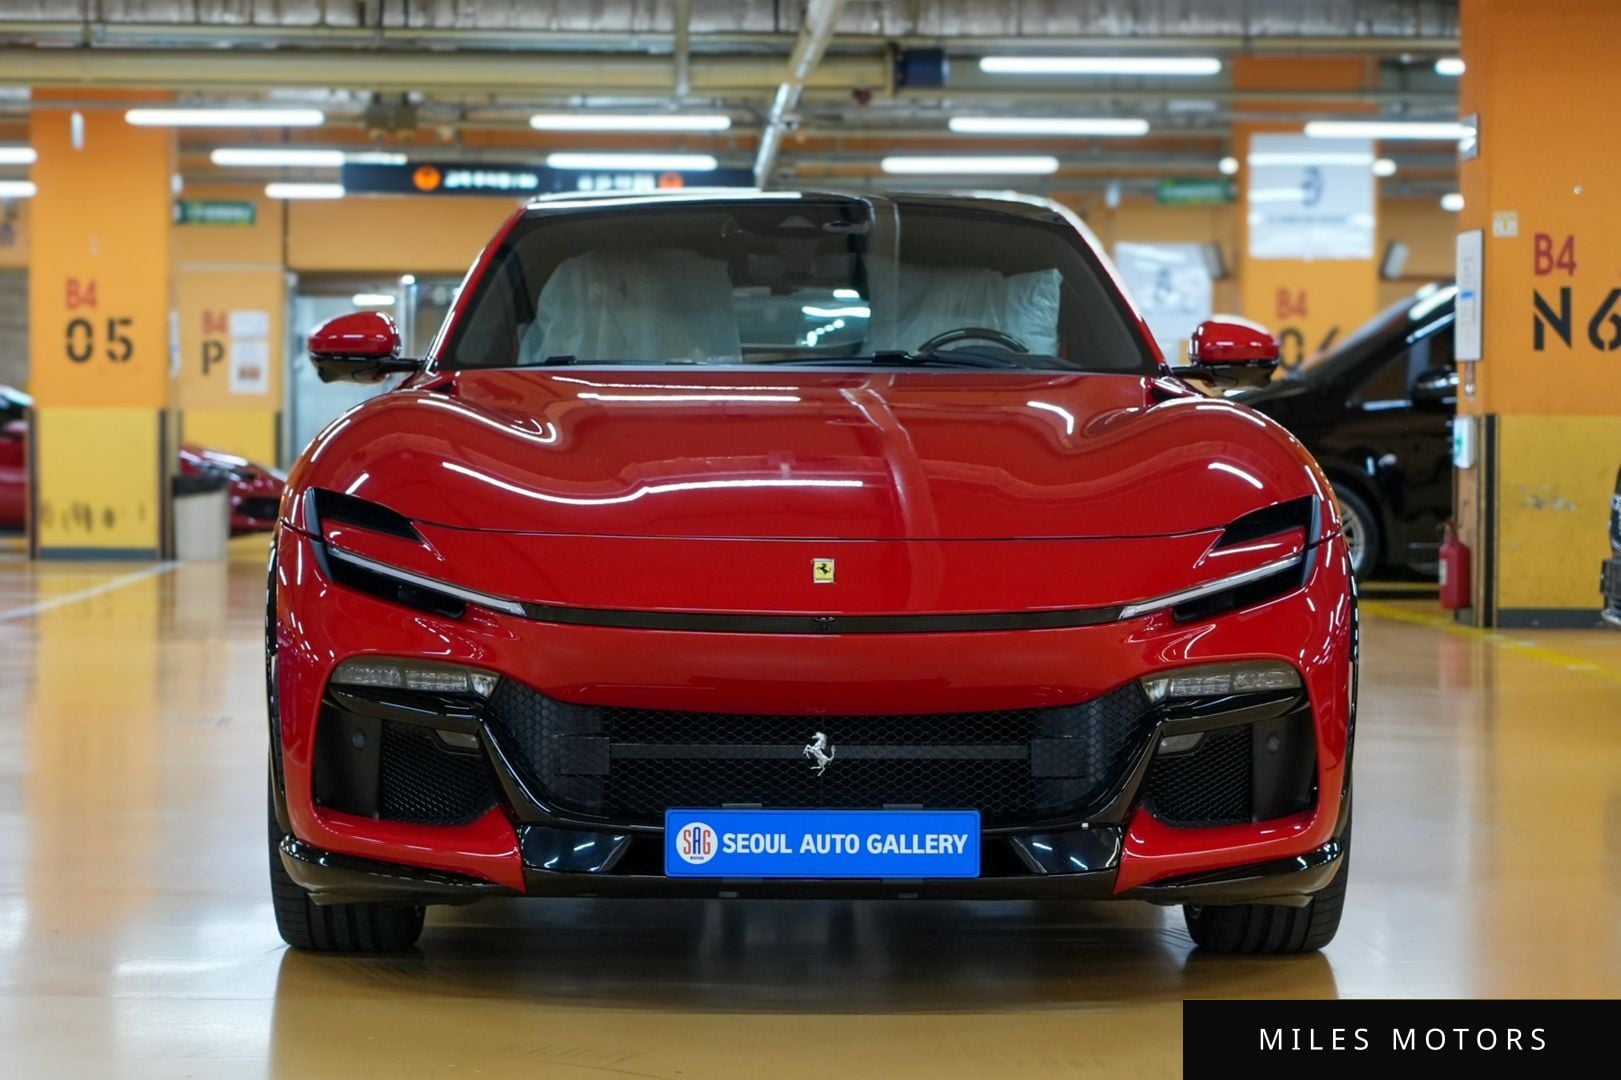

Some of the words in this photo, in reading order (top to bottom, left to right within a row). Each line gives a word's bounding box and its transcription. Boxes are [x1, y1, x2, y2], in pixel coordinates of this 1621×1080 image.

[1533, 232, 1577, 277] B4
[65, 276, 98, 310] B4
[1276, 287, 1309, 321] B4
[201, 310, 228, 335] B4
[1533, 287, 1621, 351] N6
[65, 318, 134, 363] 05
[201, 341, 225, 375] P
[683, 826, 711, 855] SAG
[722, 833, 793, 854] SEOUL
[799, 833, 860, 854] AUTO
[866, 833, 968, 854] GALLERY
